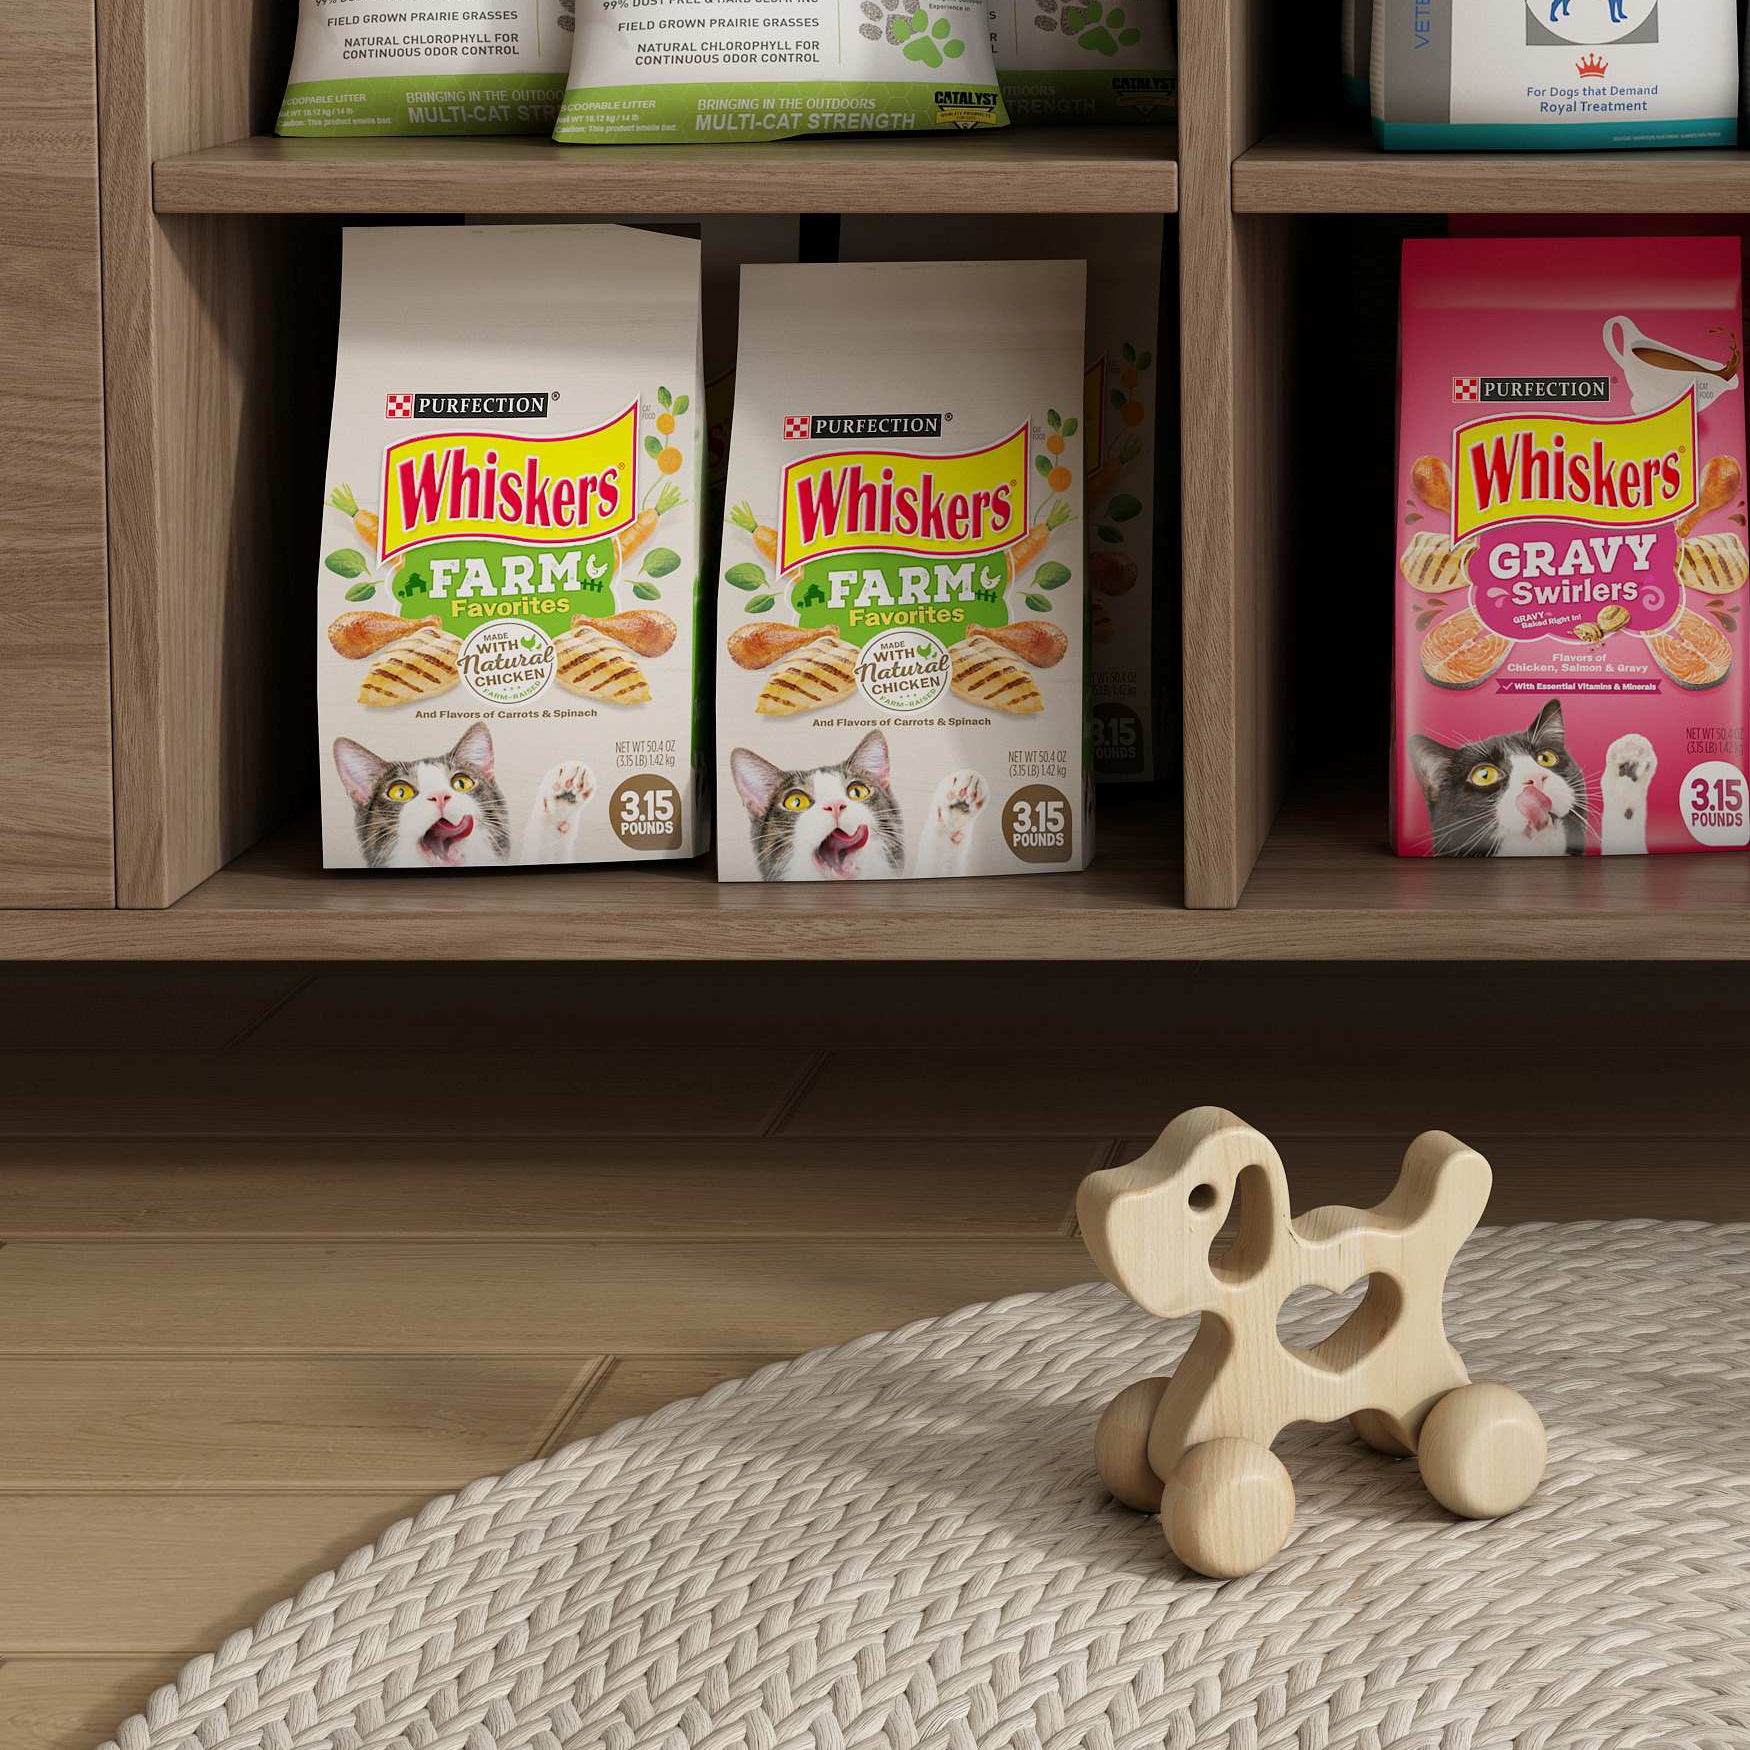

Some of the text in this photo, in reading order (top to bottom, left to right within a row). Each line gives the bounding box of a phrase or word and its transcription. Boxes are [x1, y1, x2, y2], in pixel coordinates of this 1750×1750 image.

[602, 0, 629, 10] 99%
[618, 18, 819, 32] FIELD GROWN PRAIRIE GRASSES
[637, 41, 820, 53] NATURAL CHLOROPHYLL FOR
[635, 53, 820, 66] CONTINUOUS ODOR CONTROL
[935, 91, 998, 105] CATALYST
[1527, 85, 1658, 98] For Dogs that Demand
[1540, 100, 1648, 115] Royal Treatment
[695, 112, 802, 131] MULTI-CAT
[809, 112, 916, 131] STRENGTH
[1484, 380, 1605, 398] PURFECTION
[417, 396, 546, 415] PURFECTION
[1468, 432, 1680, 512] Whiskers
[397, 446, 620, 531] Whiskers
[796, 465, 1014, 546] Whiskers
[1488, 533, 1657, 579] GRAVY
[428, 551, 582, 599] FARM
[1511, 578, 1638, 605] Swirlers
[451, 596, 570, 619] Favorites
[1513, 611, 1545, 624] GRAVY
[1522, 614, 1582, 629] Baked Right In!
[483, 633, 508, 641] MADE
[476, 640, 518, 654] WITH
[457, 646, 554, 675] Natural
[1552, 653, 1606, 662] Flavors of
[1507, 664, 1648, 673] Chicken, Salmon & Gravy
[475, 668, 545, 687] CHICKEN
[483, 681, 541, 700] FARM-RAISED
[415, 708, 598, 721] And Flavors of Carrots & Spinach
[616, 740, 676, 753] NET WT 50.4 OZ
[635, 754, 648, 768] LB)
[665, 754, 675, 767] kg
[1691, 778, 1743, 811] 3.15
[619, 789, 674, 821] 3.15
[1691, 813, 1743, 828] POUNDS
[620, 821, 674, 836] POUNDS
